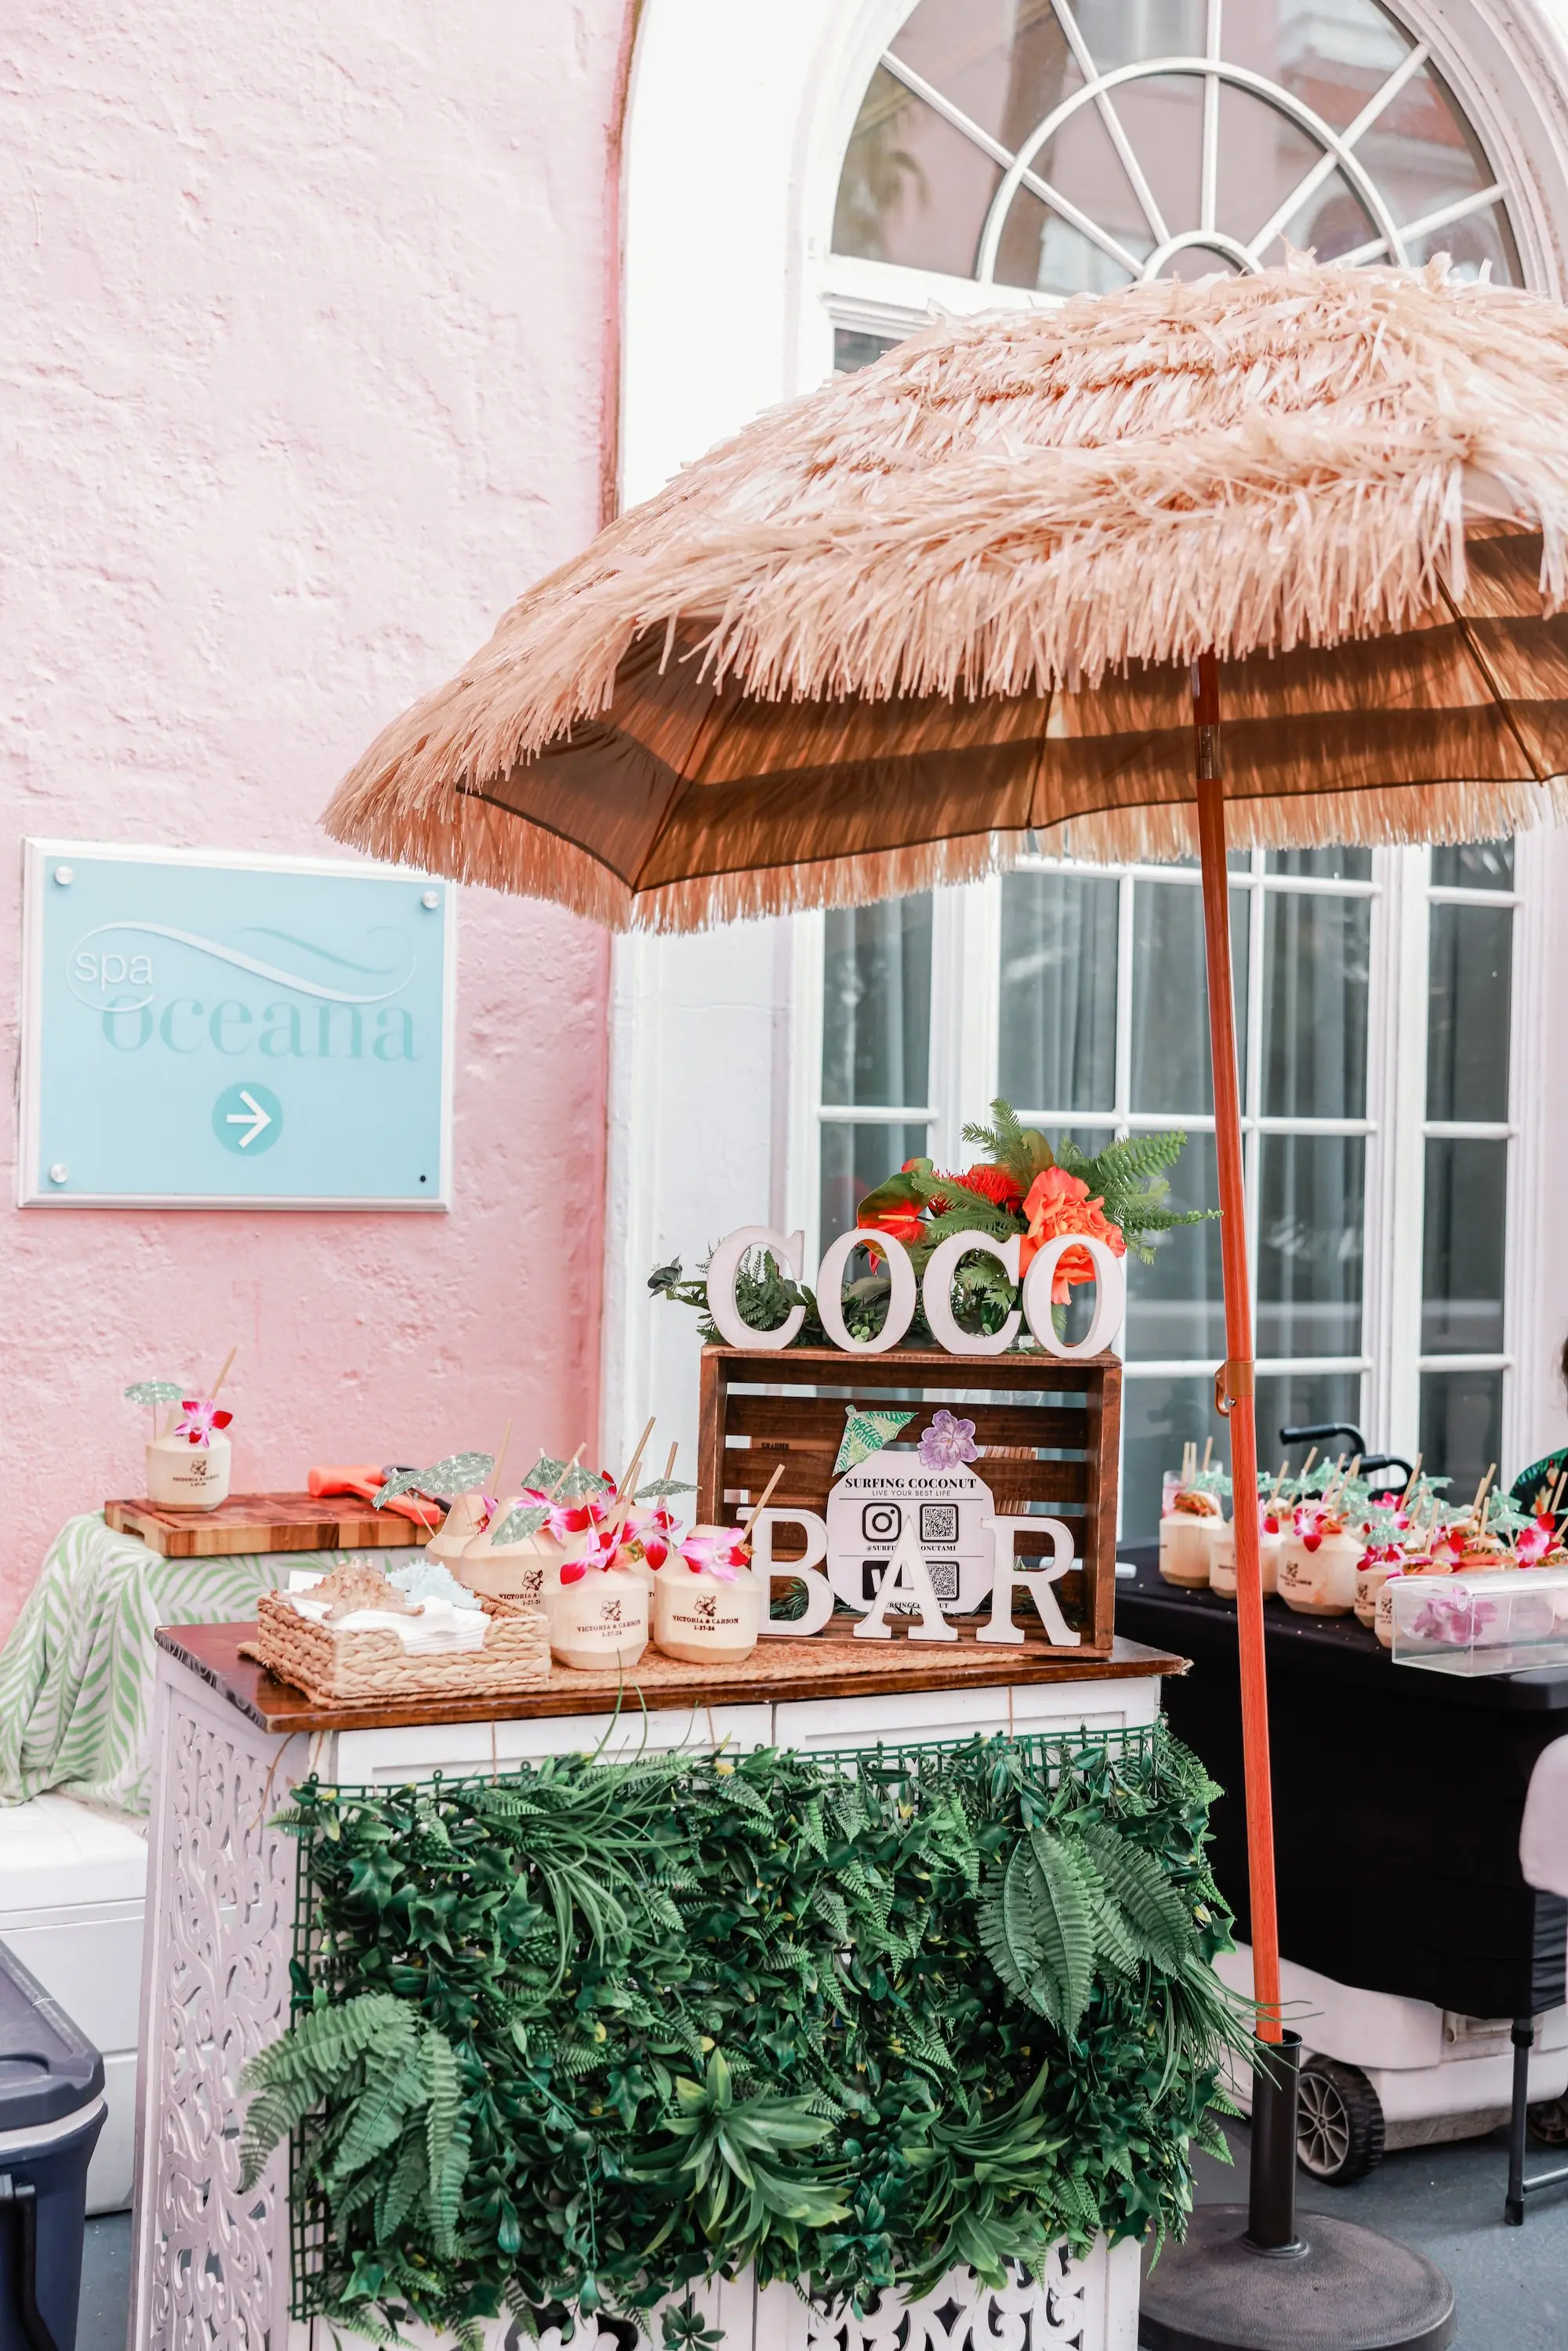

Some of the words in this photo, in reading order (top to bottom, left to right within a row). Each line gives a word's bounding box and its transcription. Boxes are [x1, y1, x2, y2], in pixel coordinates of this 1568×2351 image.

[74, 950, 154, 992] spa
[101, 994, 420, 1062] oceana
[706, 1225, 1127, 1359] COCO
[844, 1478, 905, 1489] SURFING
[908, 1478, 977, 1489] COCONUT
[735, 1505, 1081, 1647] BAR
[618, 1619, 641, 1628] CARSON
[672, 1615, 703, 1624] VICTORIA
